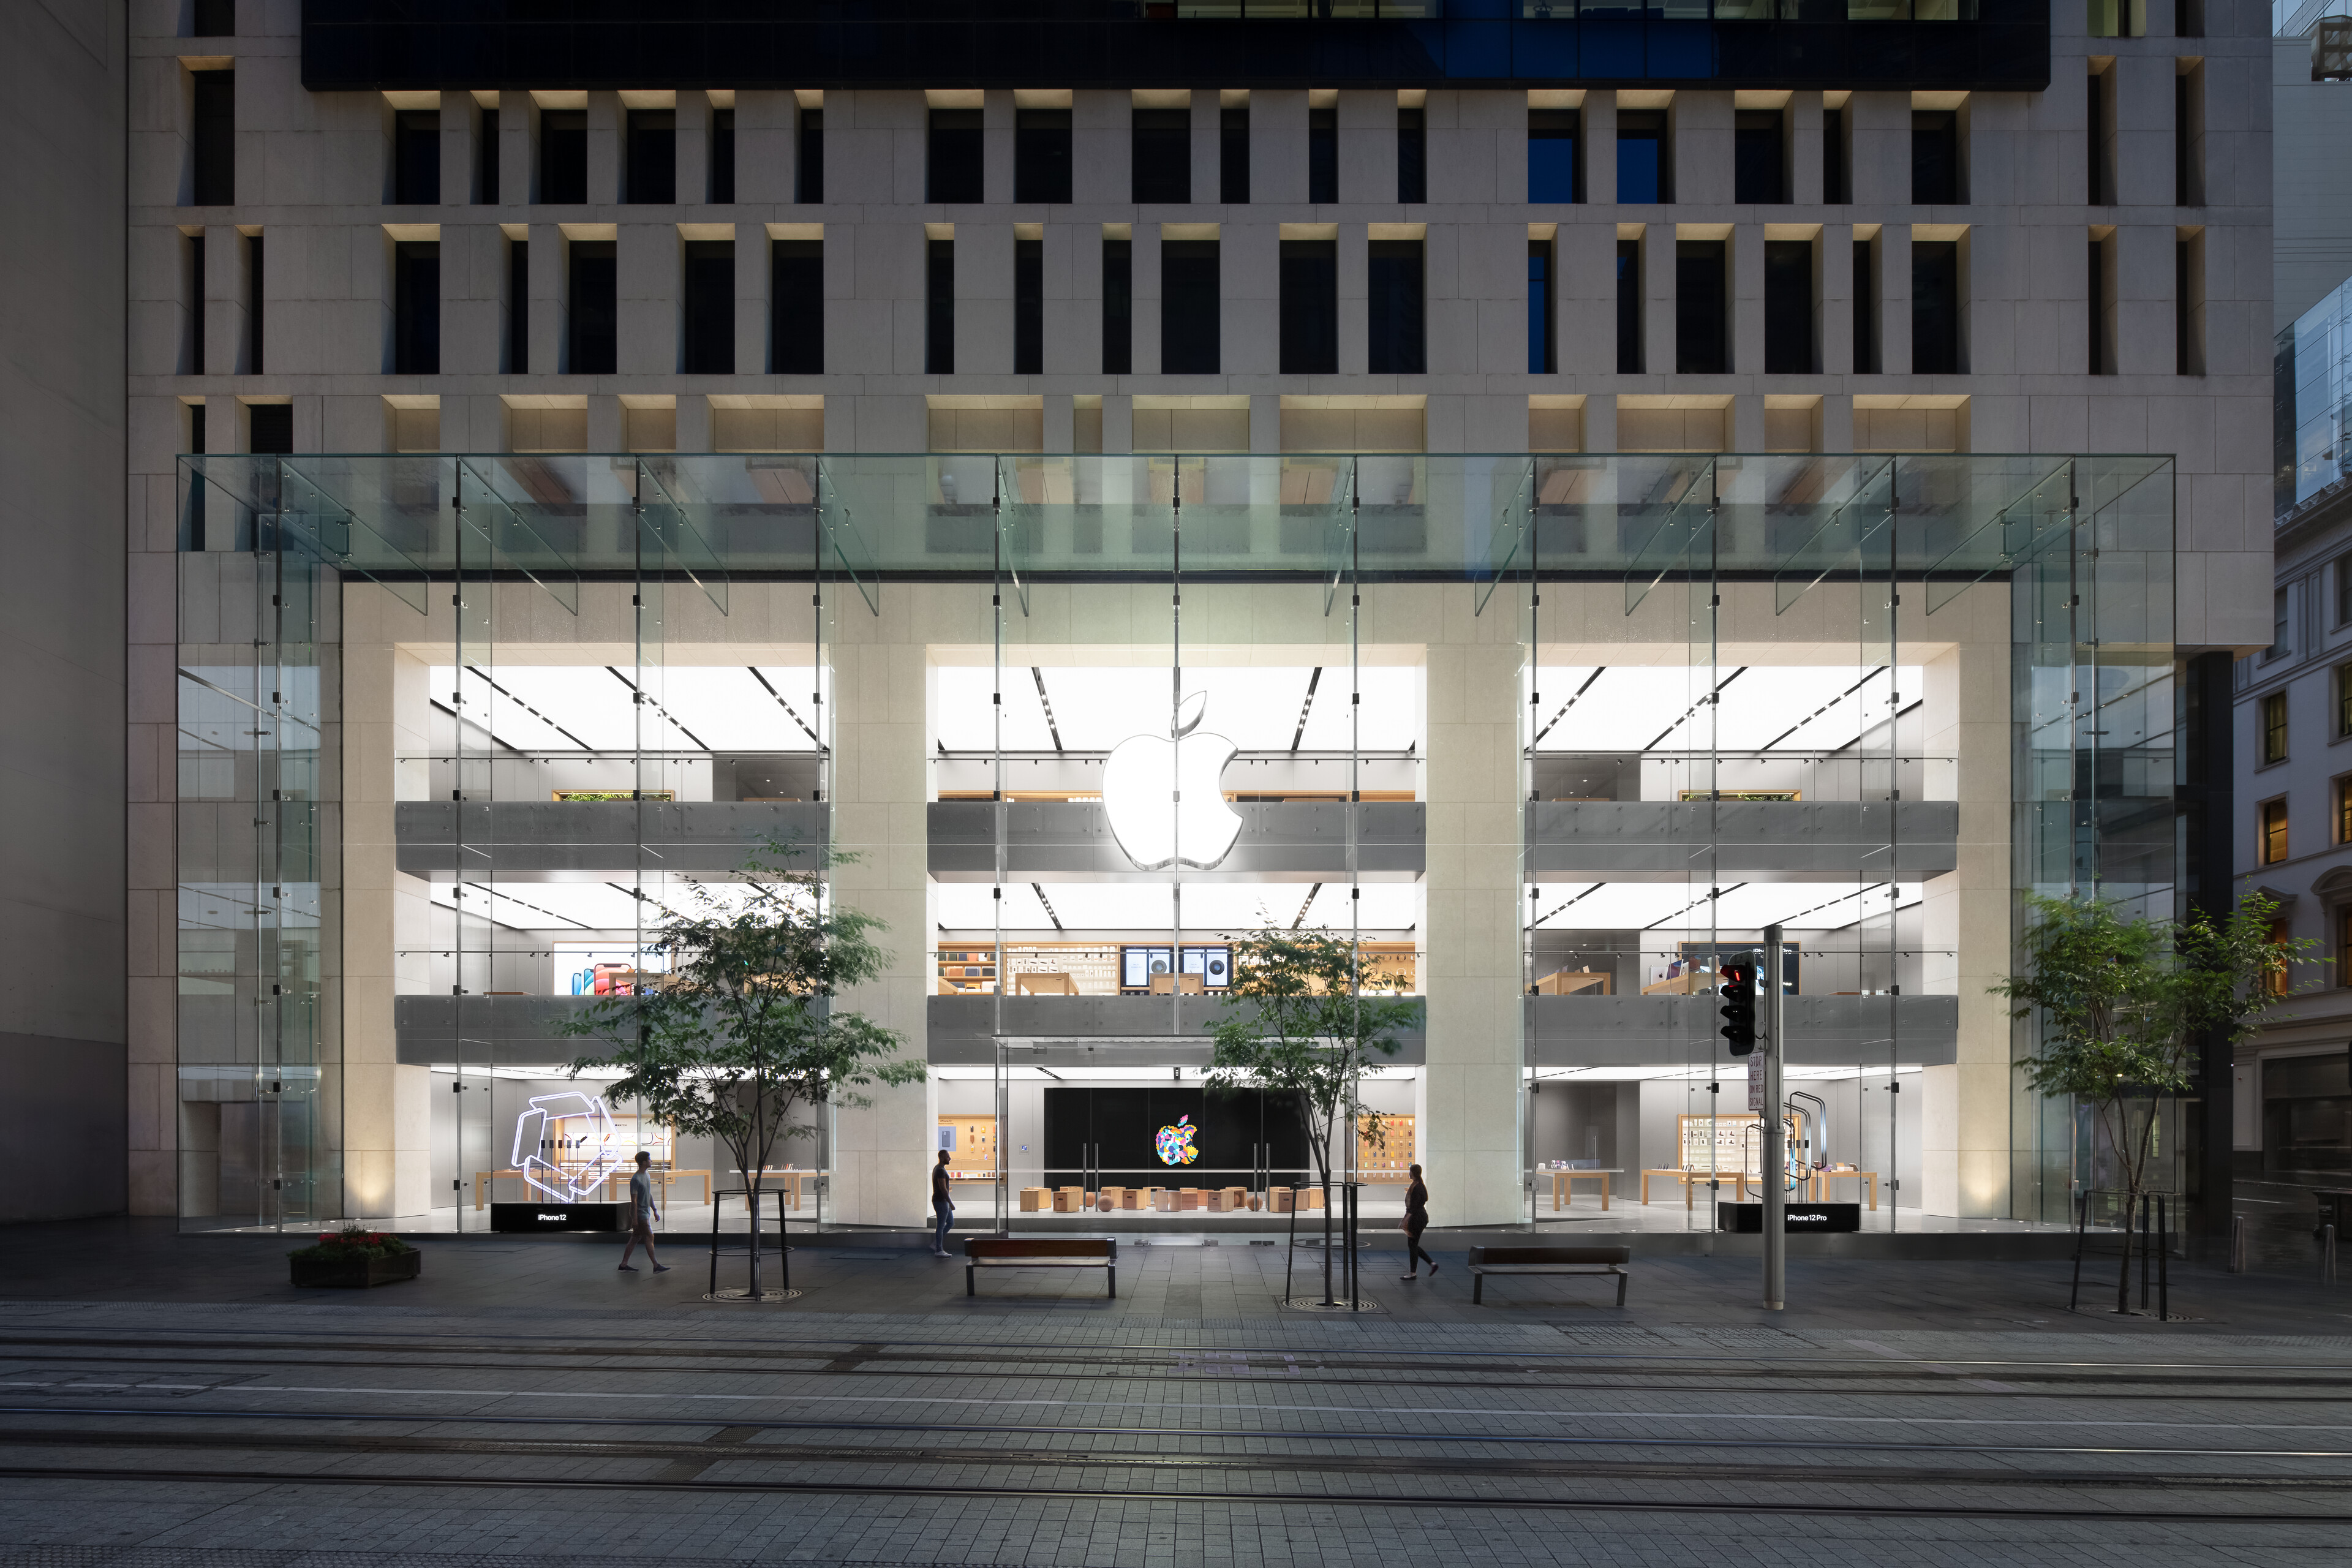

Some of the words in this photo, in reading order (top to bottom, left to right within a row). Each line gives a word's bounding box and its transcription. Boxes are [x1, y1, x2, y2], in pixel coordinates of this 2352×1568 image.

[1750, 1055, 1762, 1067] STOP
[1750, 1070, 1763, 1081] HERE
[1749, 1085, 1755, 1093] ON
[1749, 1097, 1763, 1106] SIGNAL
